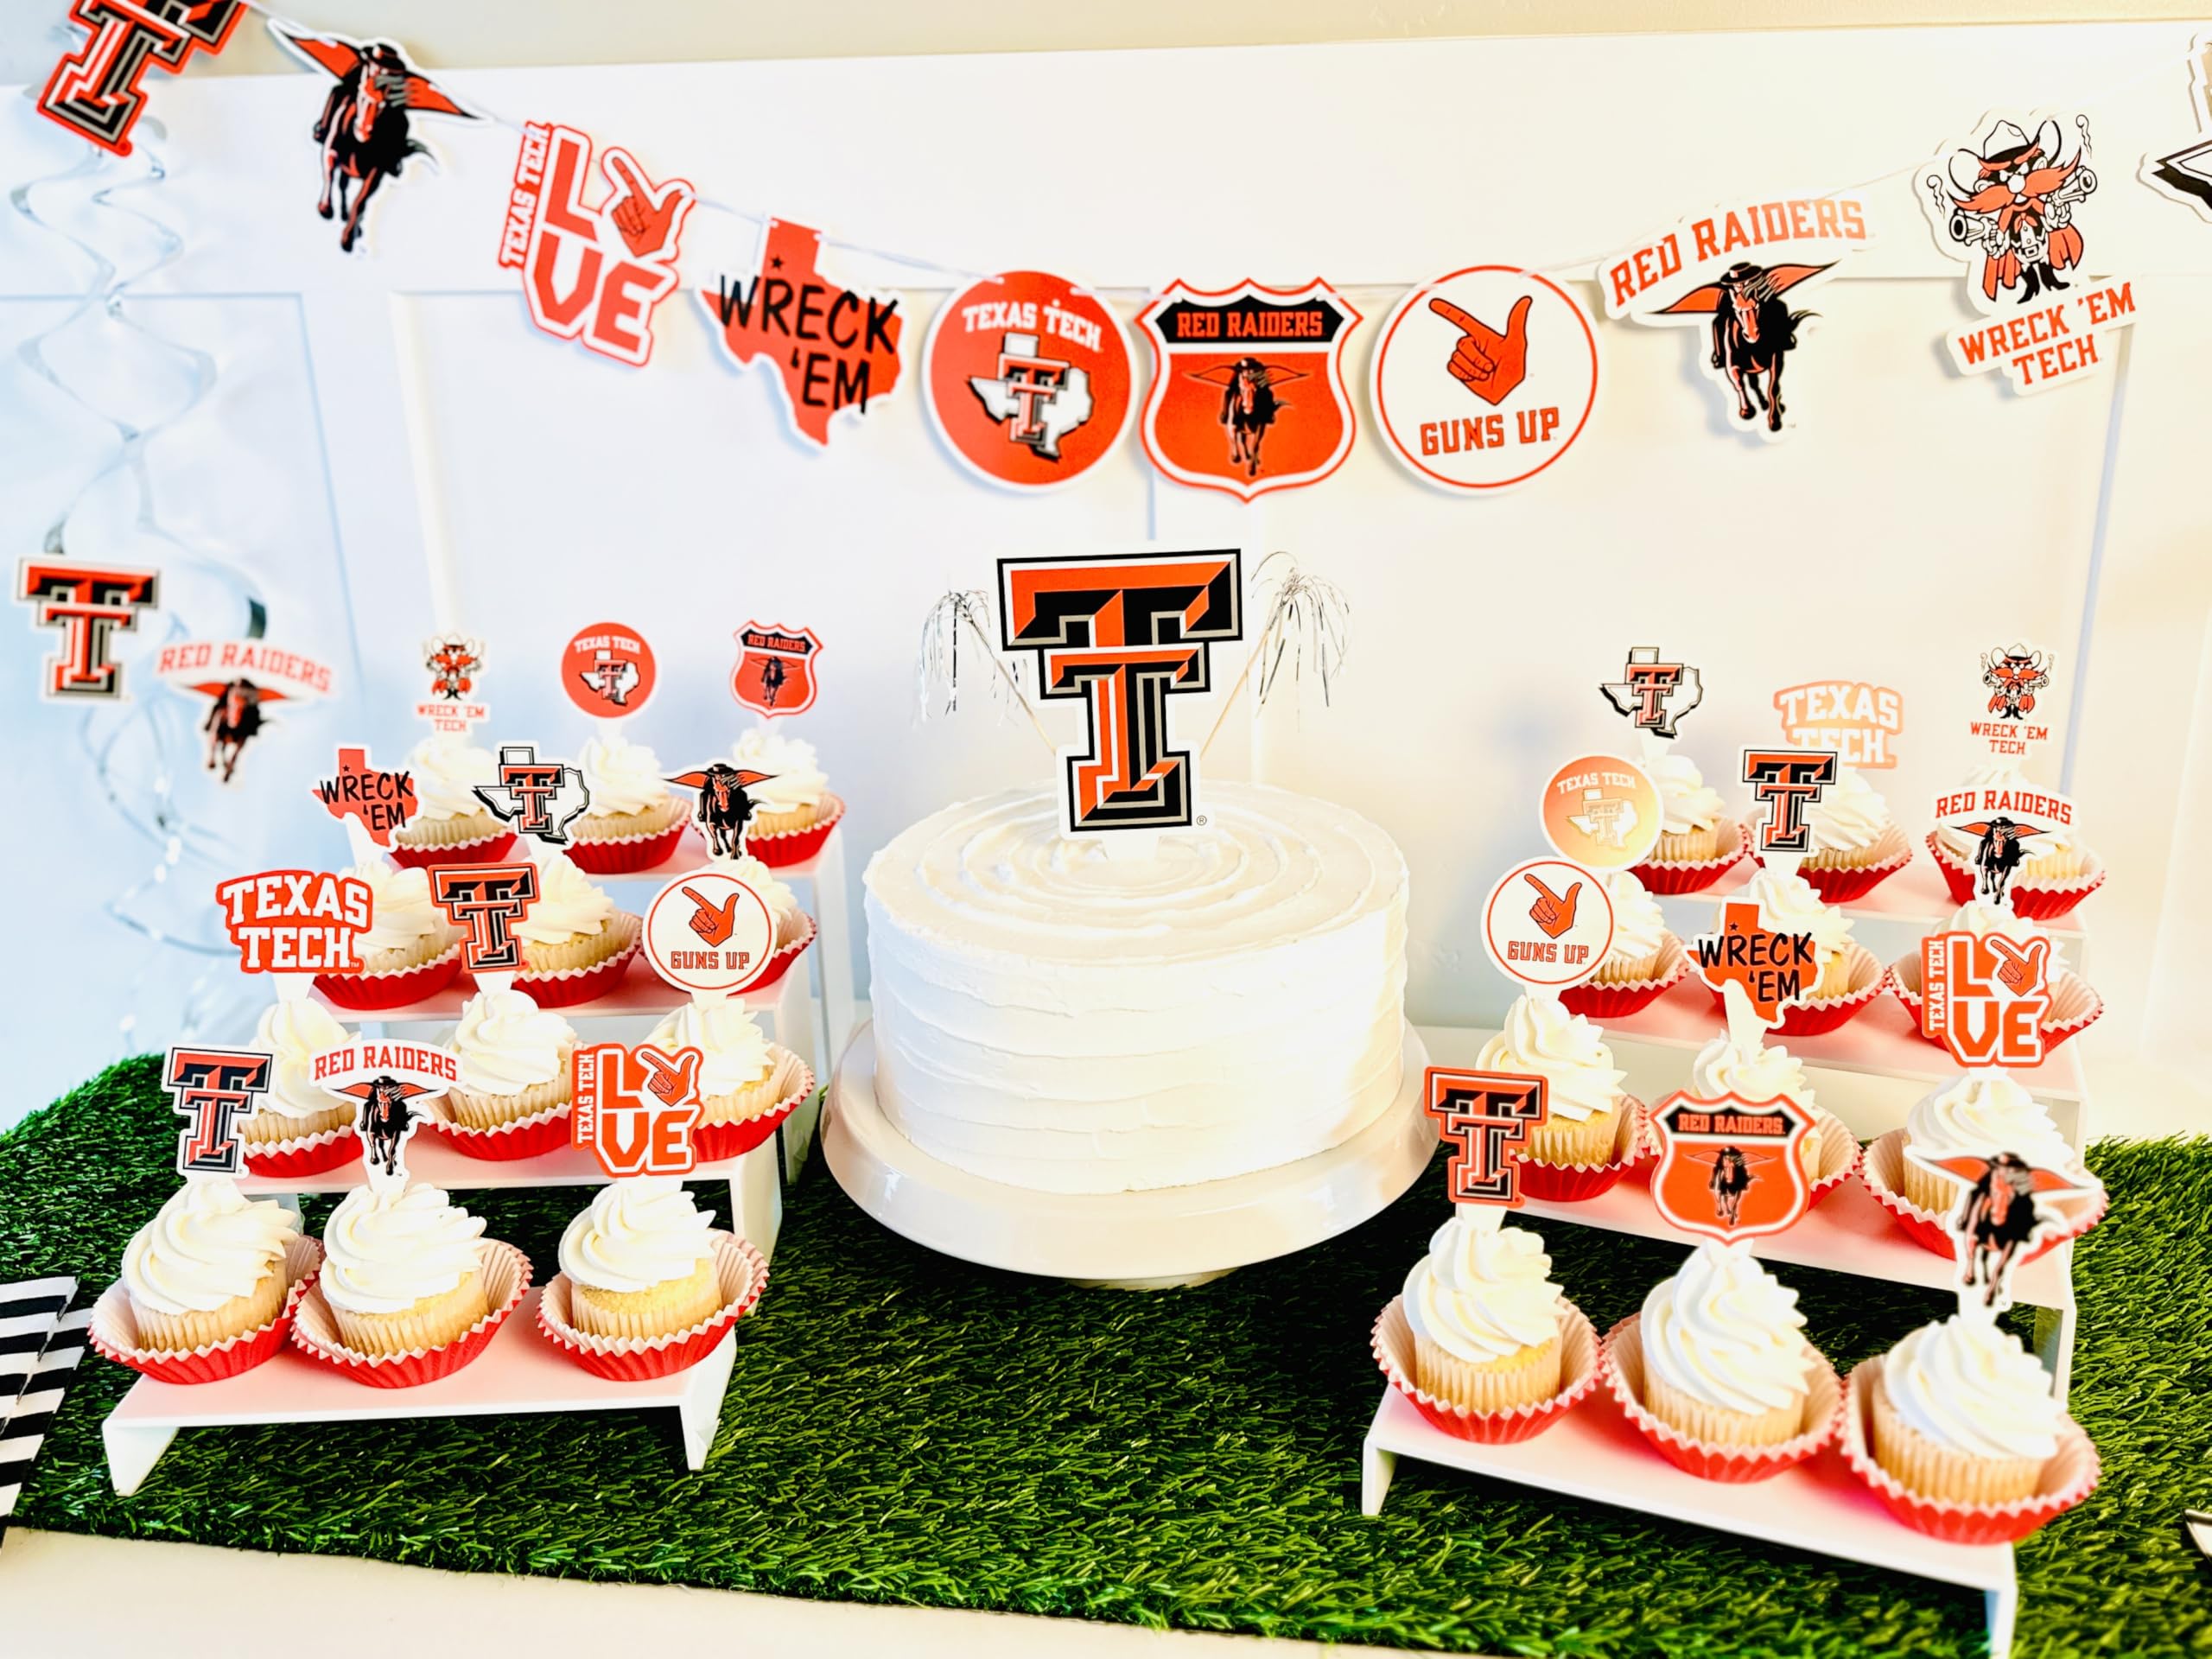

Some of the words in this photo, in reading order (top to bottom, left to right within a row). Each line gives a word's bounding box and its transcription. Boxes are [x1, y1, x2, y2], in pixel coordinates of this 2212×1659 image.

[500, 188, 537, 264] TEXAS
[519, 124, 550, 185] TECH
[1609, 234, 1682, 308] RED
[1691, 199, 1867, 264] RAIDERS
[719, 275, 899, 354] WRECK
[963, 302, 1038, 333] TEXAS
[1043, 306, 1103, 352] TECH
[1176, 312, 1220, 338] RED
[1227, 311, 1323, 337] RAIDERS
[1958, 304, 2070, 365] WRECK
[2077, 282, 2136, 326] 'EM
[2012, 334, 2099, 385] TECH
[1420, 414, 1504, 456] GUNS
[1516, 406, 1560, 444] UP
[575, 635, 610, 654] TEXAS
[612, 637, 641, 654] TECH
[747, 634, 766, 646] RED
[767, 637, 805, 652] RAIDERS
[158, 644, 210, 675] RED
[221, 642, 333, 695] RAIDERS
[416, 703, 458, 718] WRECK
[1779, 685, 1898, 729] TEXAS
[435, 719, 467, 732] TECH
[1970, 721, 2018, 738] WRECK
[1989, 740, 2025, 754] TECH
[320, 770, 413, 804] WRECK
[1557, 772, 1599, 794] TEXAS
[1602, 772, 1637, 789] TECH
[1936, 791, 1975, 818] RED
[1984, 791, 2072, 825] RAIDERS
[223, 874, 368, 927] TEXAS
[238, 927, 351, 968] TECH
[671, 951, 718, 969] GUNS
[726, 952, 749, 969] UP
[1508, 941, 1557, 963] GUNS
[1564, 944, 1589, 964] UP
[1699, 932, 1812, 968] WRECK
[1929, 940, 1944, 979] TECH
[1929, 982, 1944, 1031] TEXAS
[315, 1048, 354, 1080] RED
[363, 1046, 456, 1081] RAIDERS
[578, 1054, 594, 1091] TECH
[577, 1096, 594, 1144] TEXAS
[1678, 1114, 1710, 1133] RED
[1714, 1115, 1785, 1135] RAIDERS
